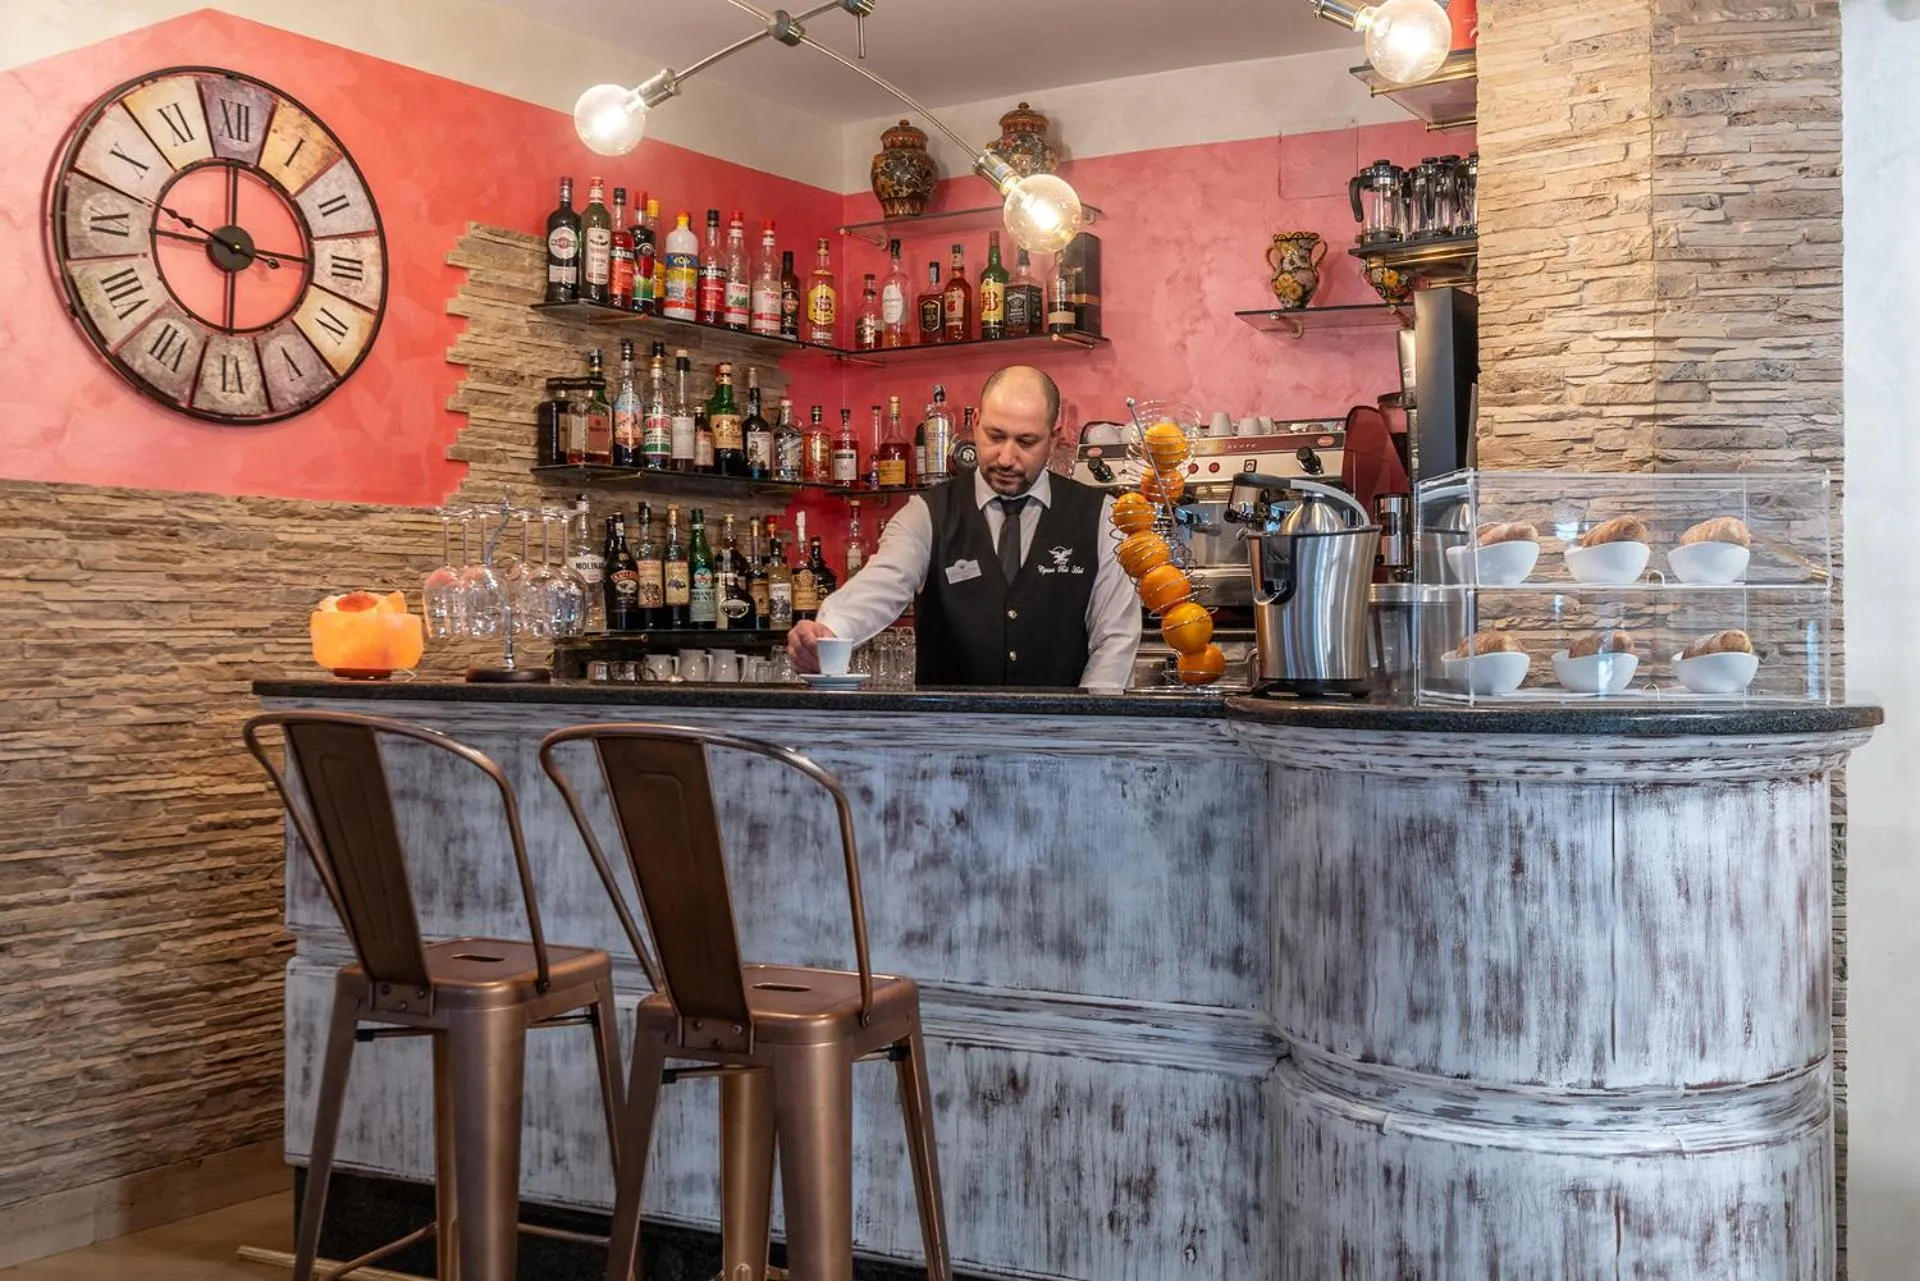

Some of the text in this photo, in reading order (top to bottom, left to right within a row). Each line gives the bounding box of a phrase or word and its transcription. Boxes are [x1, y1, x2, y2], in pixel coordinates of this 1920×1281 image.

[157, 102, 195, 147] XI
[219, 98, 250, 143] XII
[109, 141, 150, 179] X
[284, 138, 305, 167] I
[89, 206, 130, 238] IX
[318, 194, 351, 217] II
[330, 255, 364, 281] III
[100, 267, 150, 321] VIII
[314, 307, 349, 346] IV
[148, 323, 189, 373] VII
[280, 345, 304, 382] V
[220, 354, 245, 395] VI
